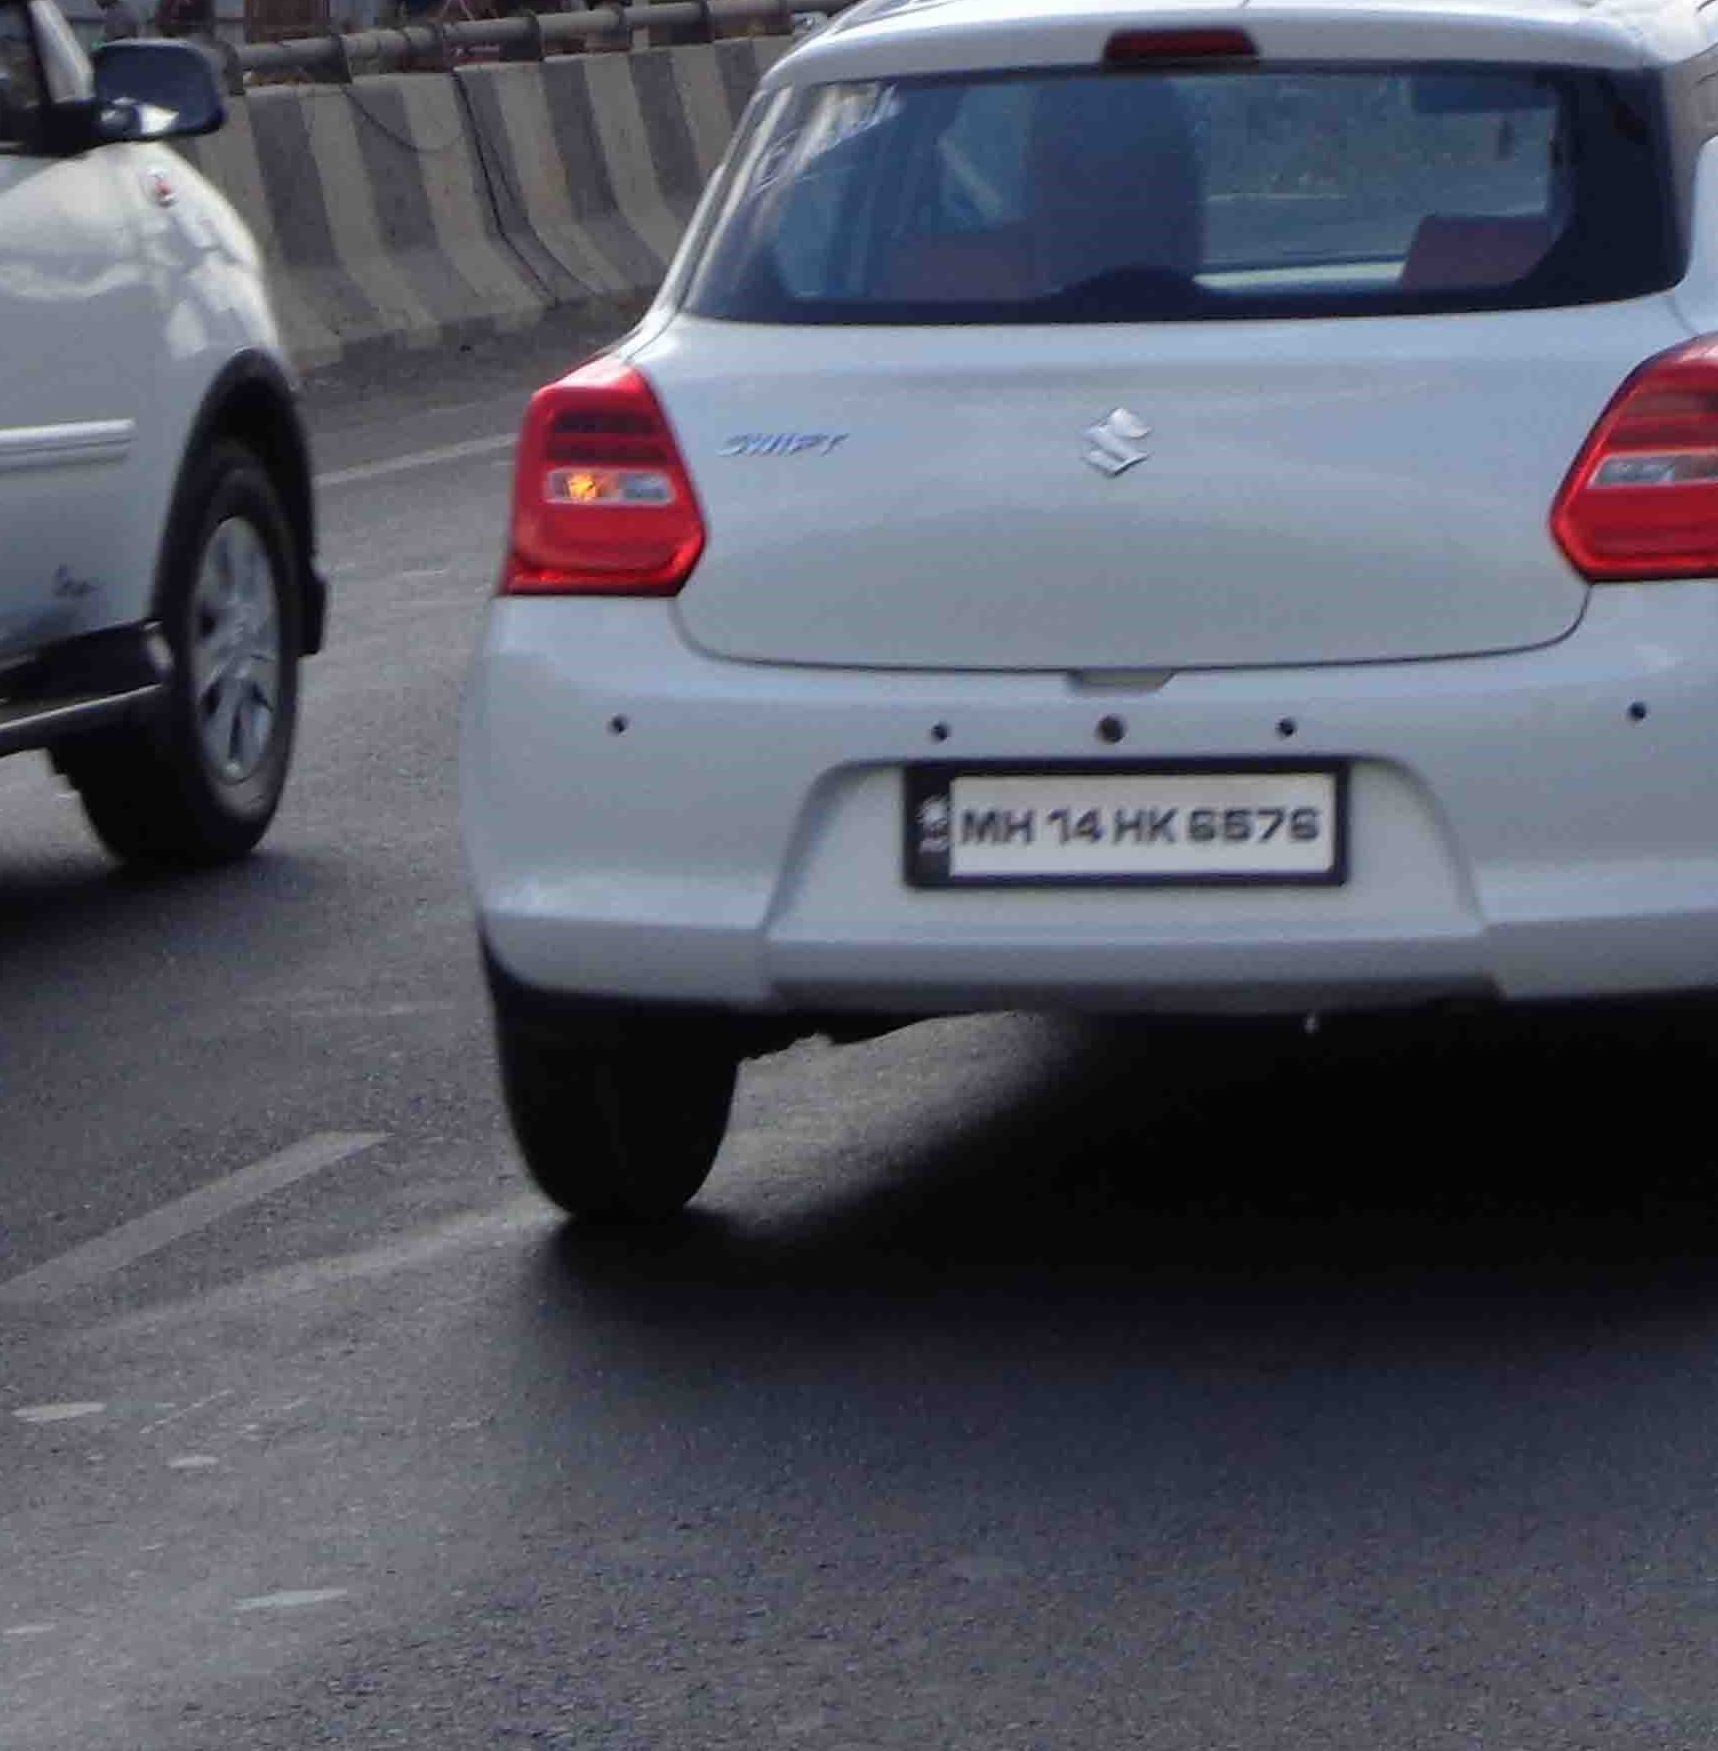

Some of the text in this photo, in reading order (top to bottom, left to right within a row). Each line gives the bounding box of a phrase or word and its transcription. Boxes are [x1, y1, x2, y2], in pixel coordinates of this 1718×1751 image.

[960, 807, 1035, 846] MH
[1047, 807, 1103, 845] 14
[1112, 806, 1177, 844] HK
